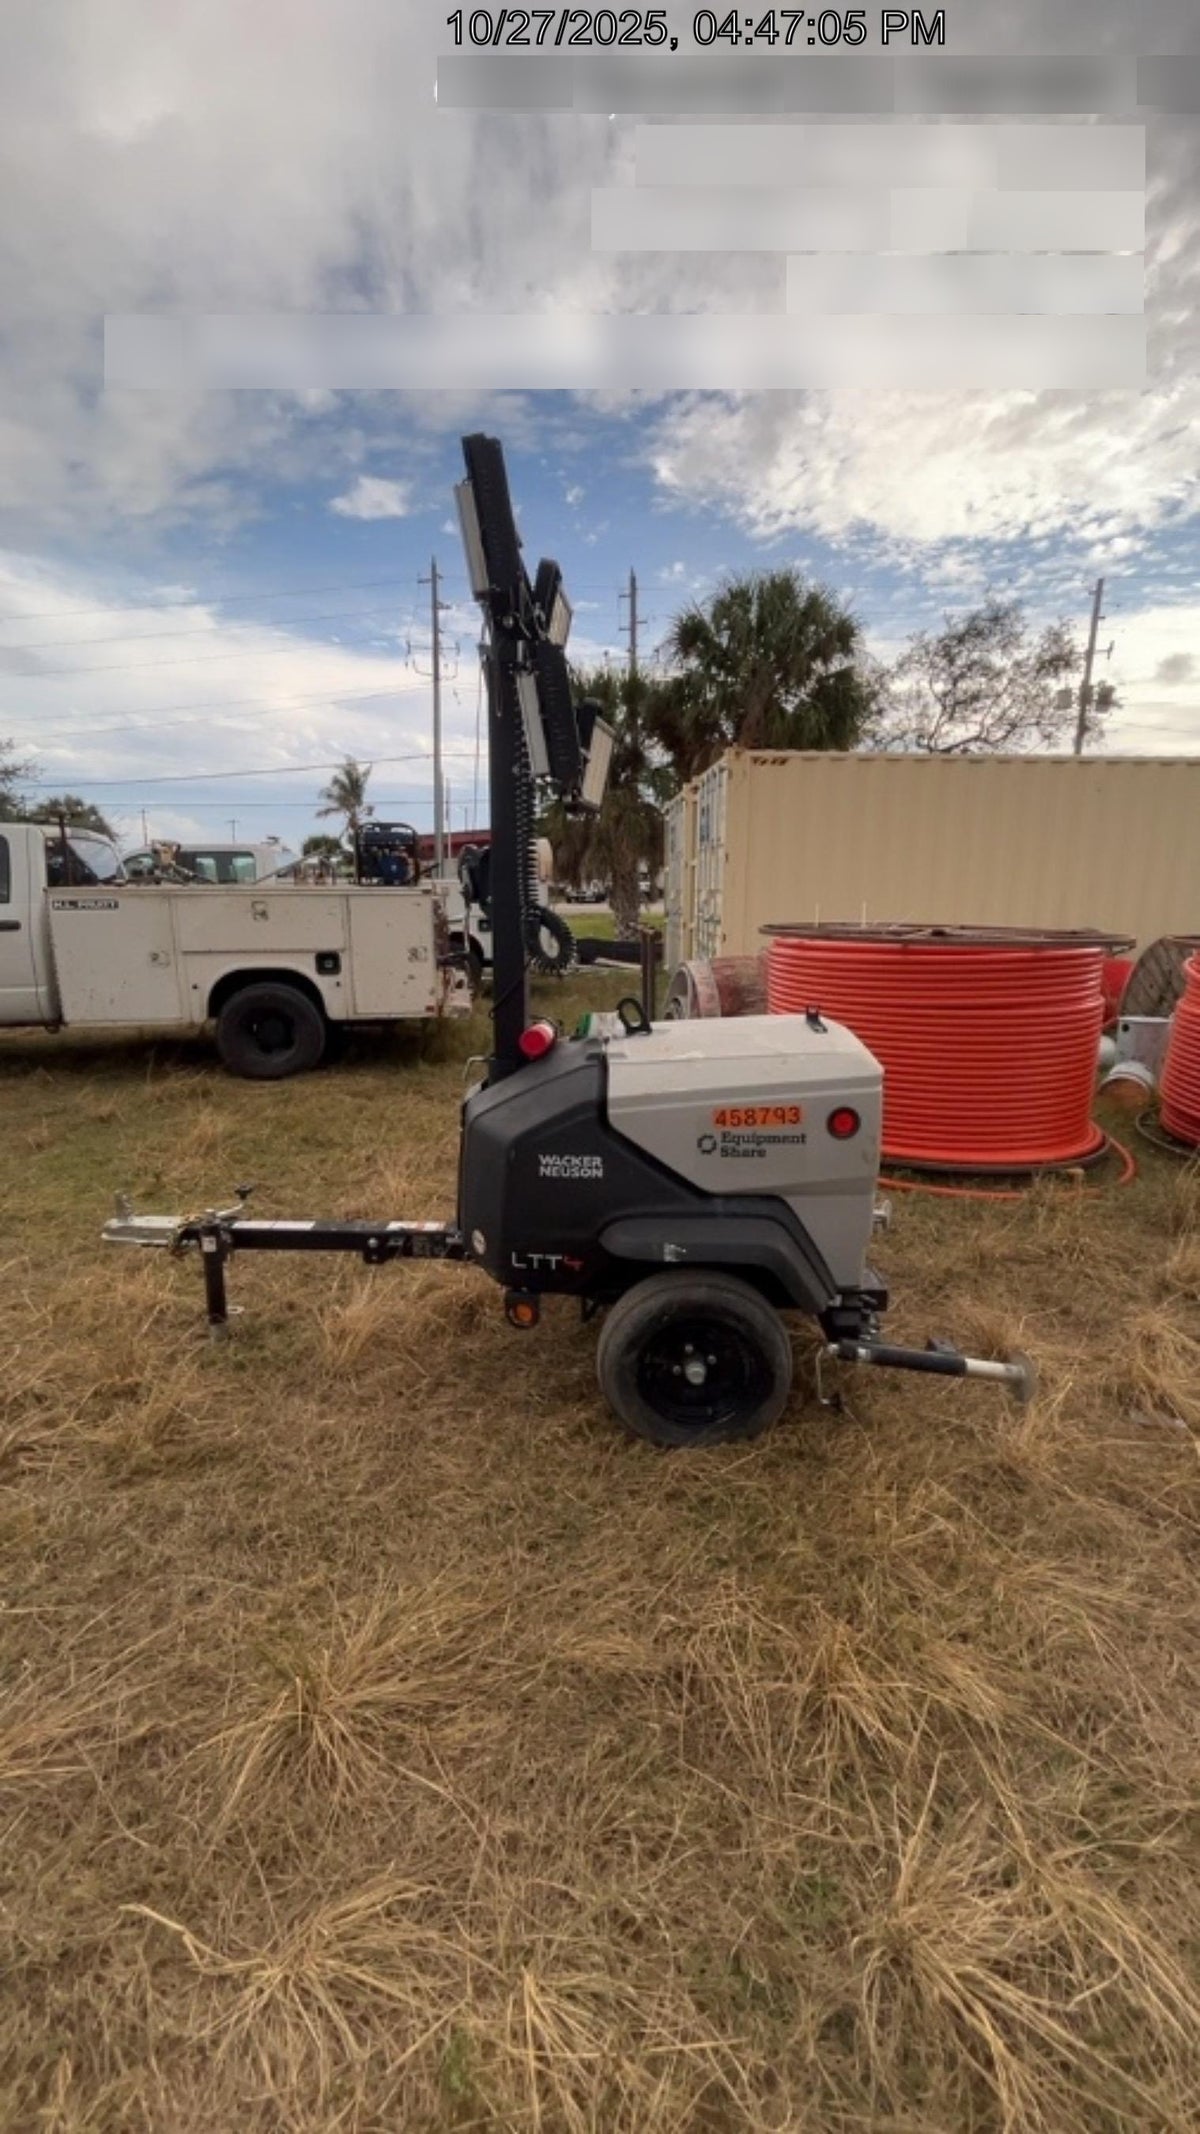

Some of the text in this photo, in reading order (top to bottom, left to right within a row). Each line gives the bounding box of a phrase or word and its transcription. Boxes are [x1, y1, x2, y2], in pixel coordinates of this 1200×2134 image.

[714, 1106, 801, 1128] 458793
[720, 1131, 806, 1146] Equipment
[720, 1145, 767, 1158] Share
[538, 1154, 602, 1167] WACKER
[539, 1166, 603, 1178] NEUSON
